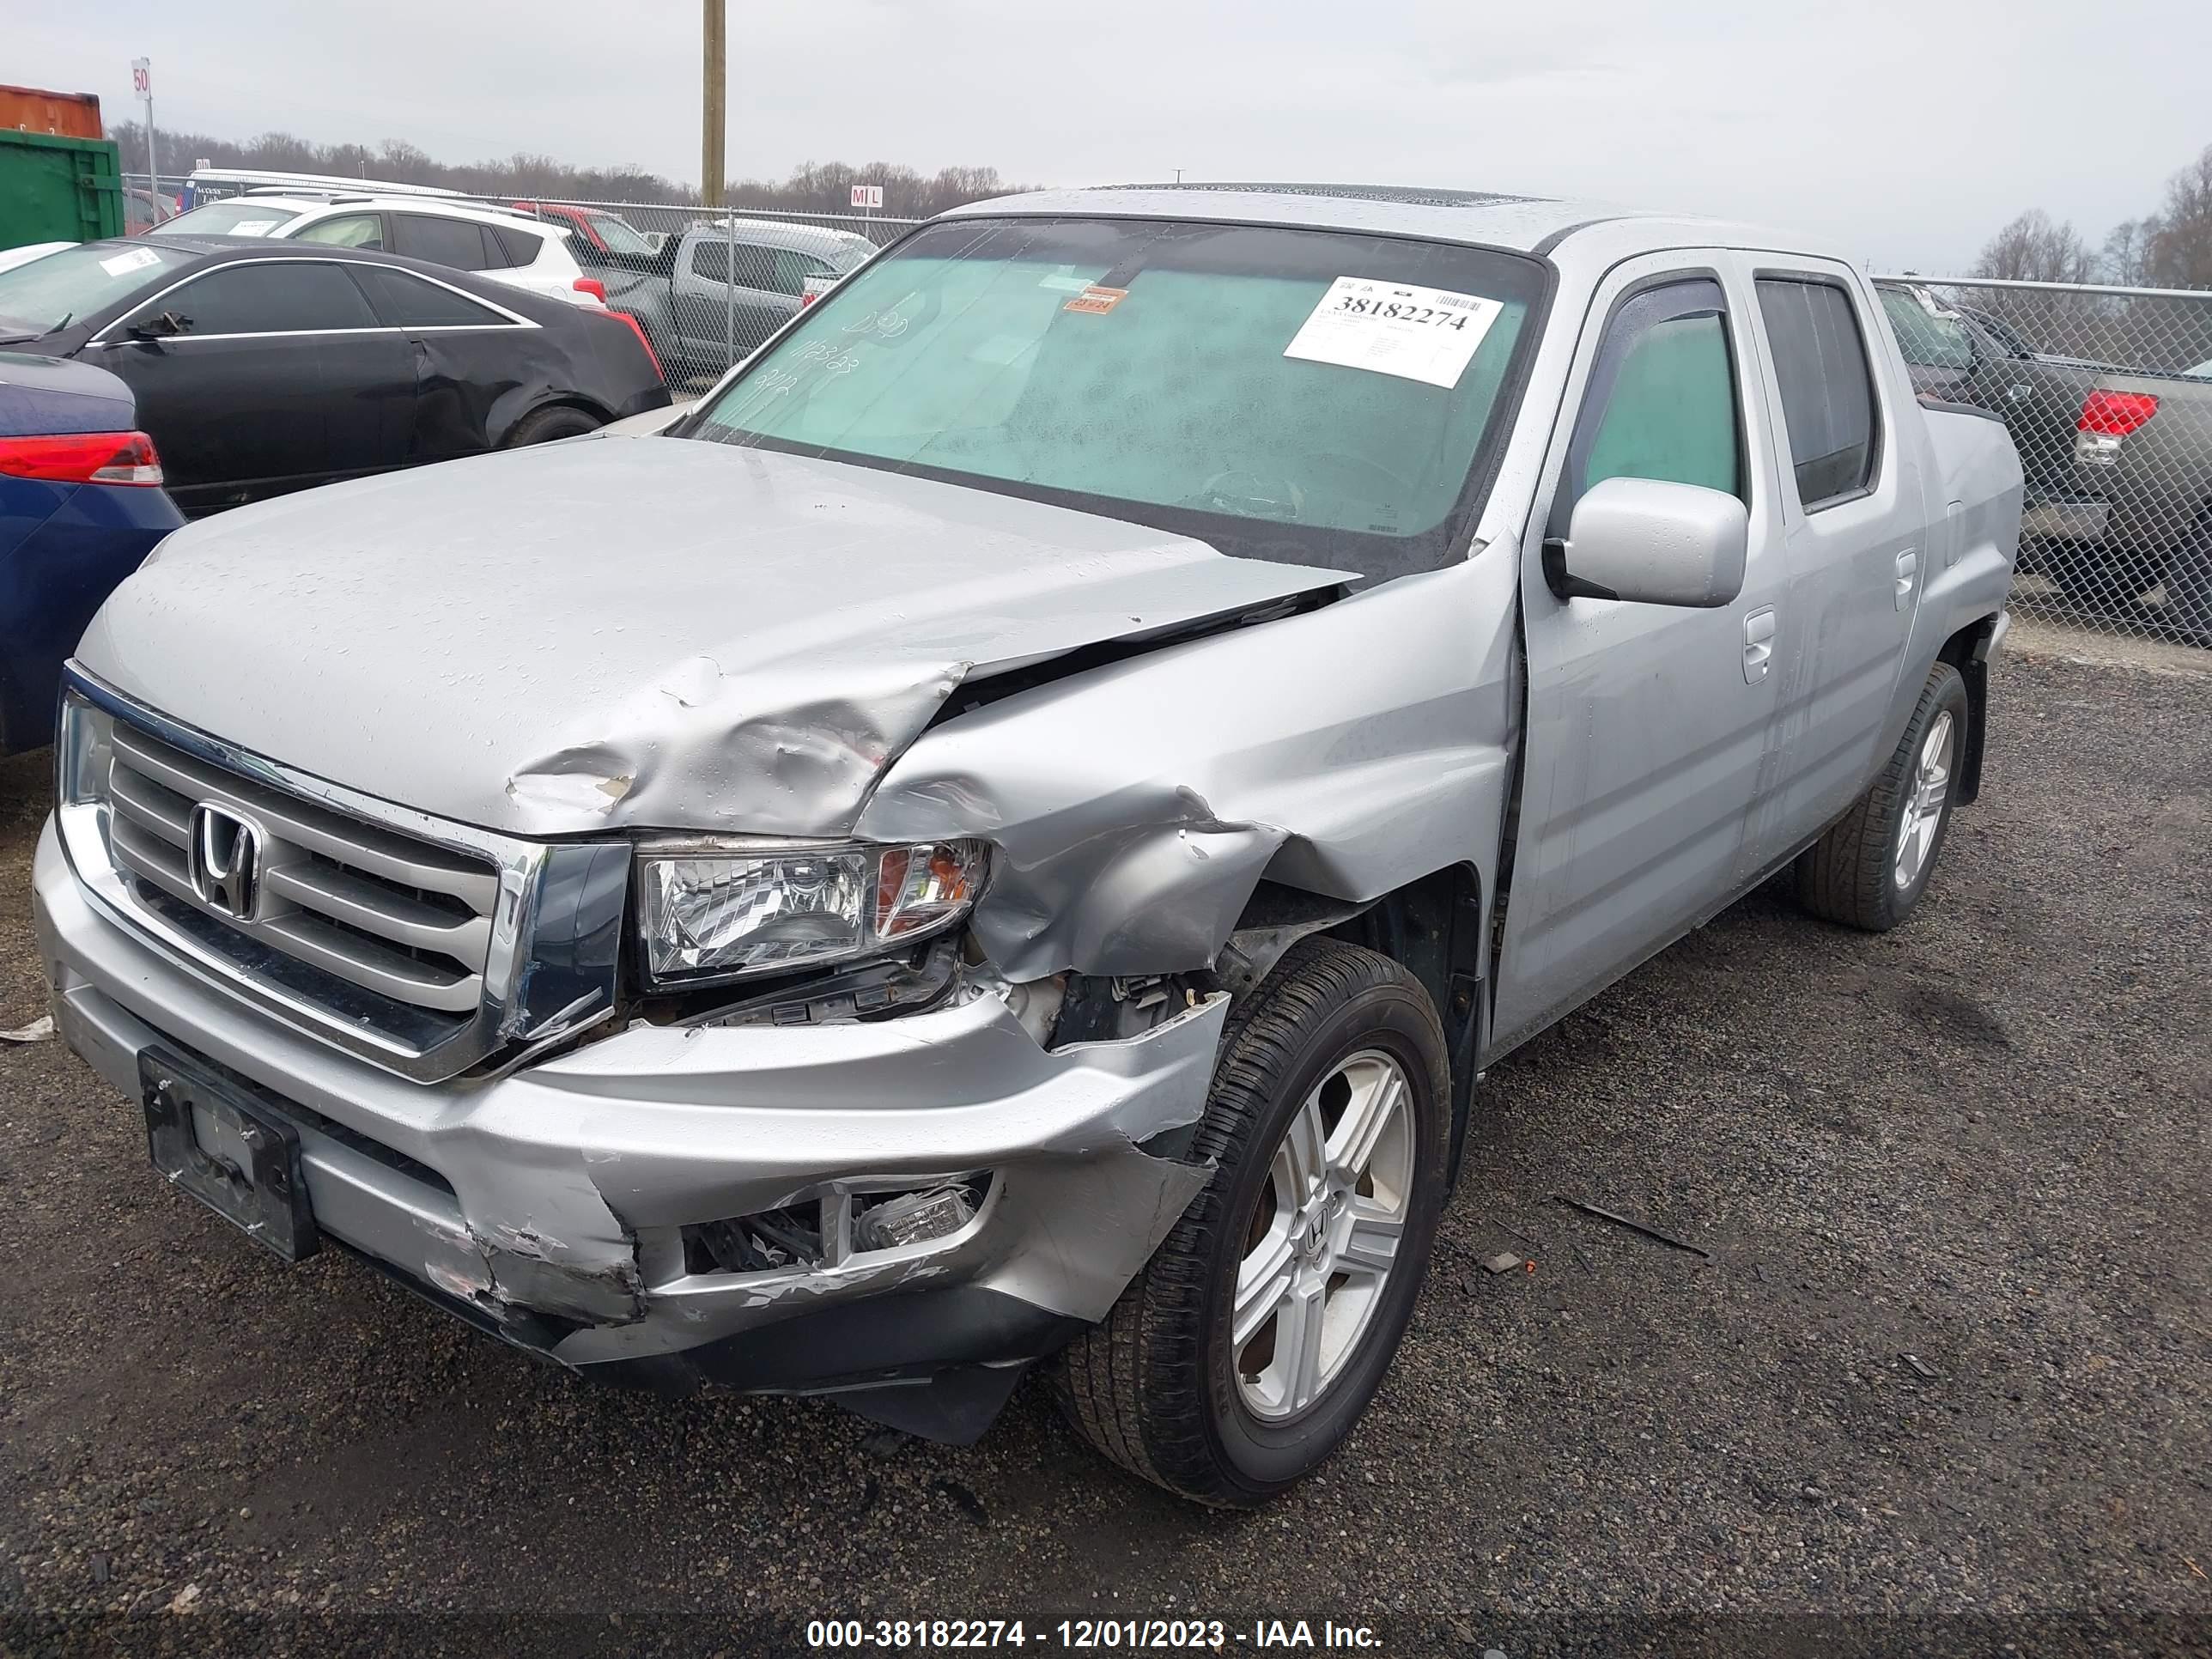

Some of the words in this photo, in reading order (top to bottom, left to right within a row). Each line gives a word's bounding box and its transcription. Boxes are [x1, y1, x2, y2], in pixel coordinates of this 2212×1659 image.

[133, 68, 148, 92] 50
[853, 189, 864, 204] M
[872, 190, 879, 204] L
[1334, 296, 1468, 331] 38182274
